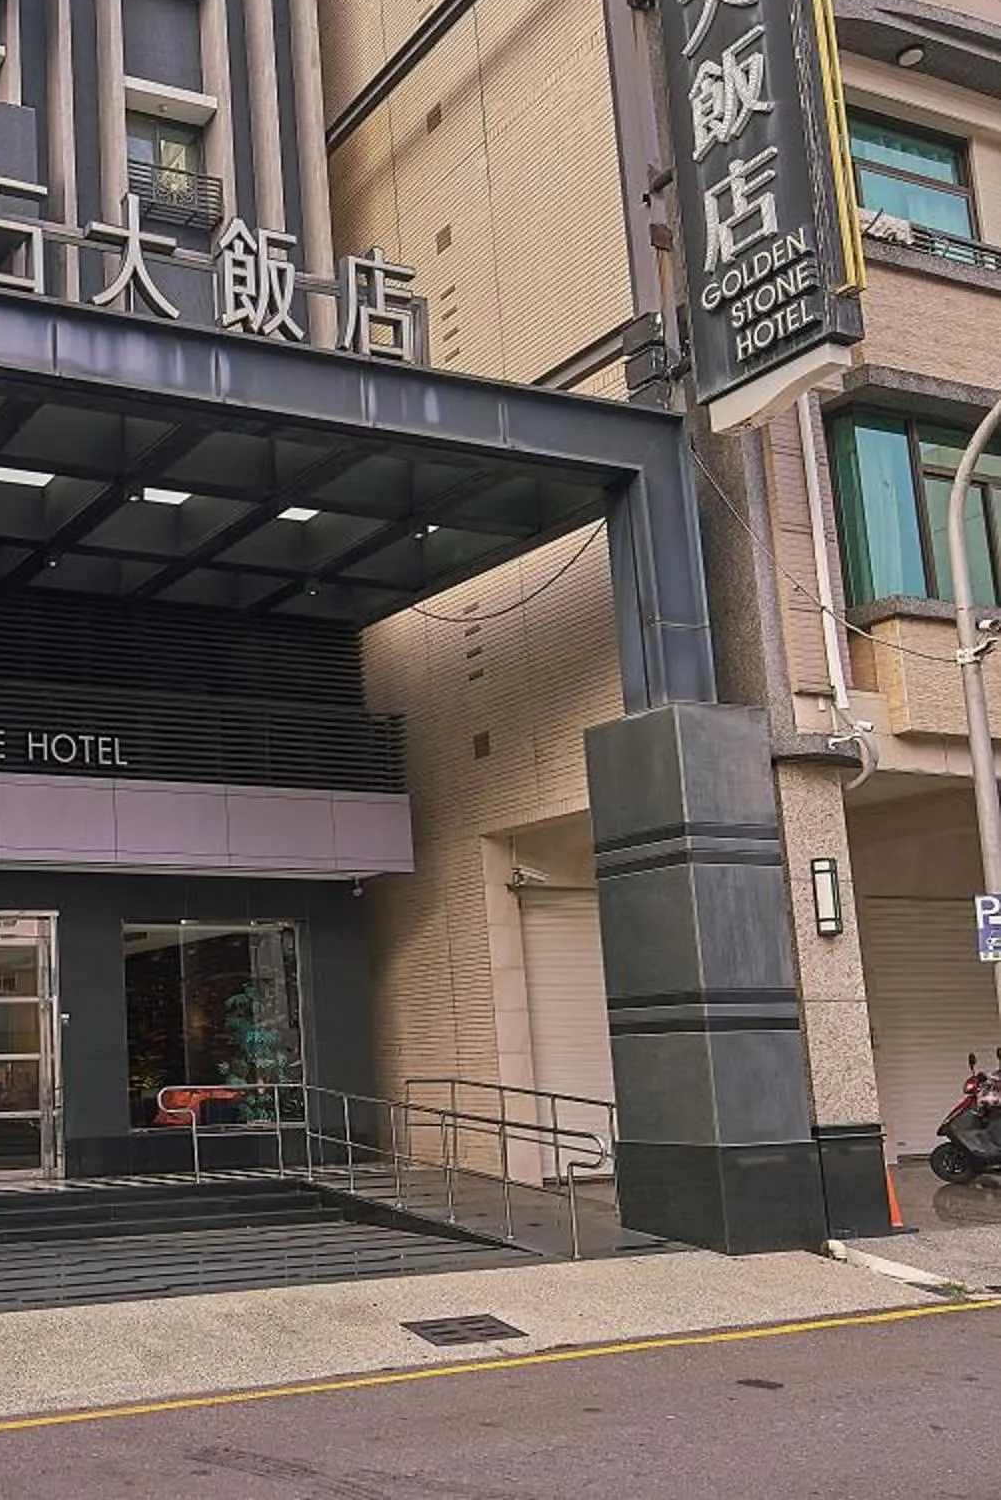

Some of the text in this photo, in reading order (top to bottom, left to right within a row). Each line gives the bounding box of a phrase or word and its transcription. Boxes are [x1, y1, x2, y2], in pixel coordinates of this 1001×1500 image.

[702, 227, 807, 310] GOLDEN
[731, 261, 811, 328] STONE
[736, 299, 814, 362] HOTEL
[27, 731, 128, 765] HOTEL
[975, 895, 1000, 929] P
